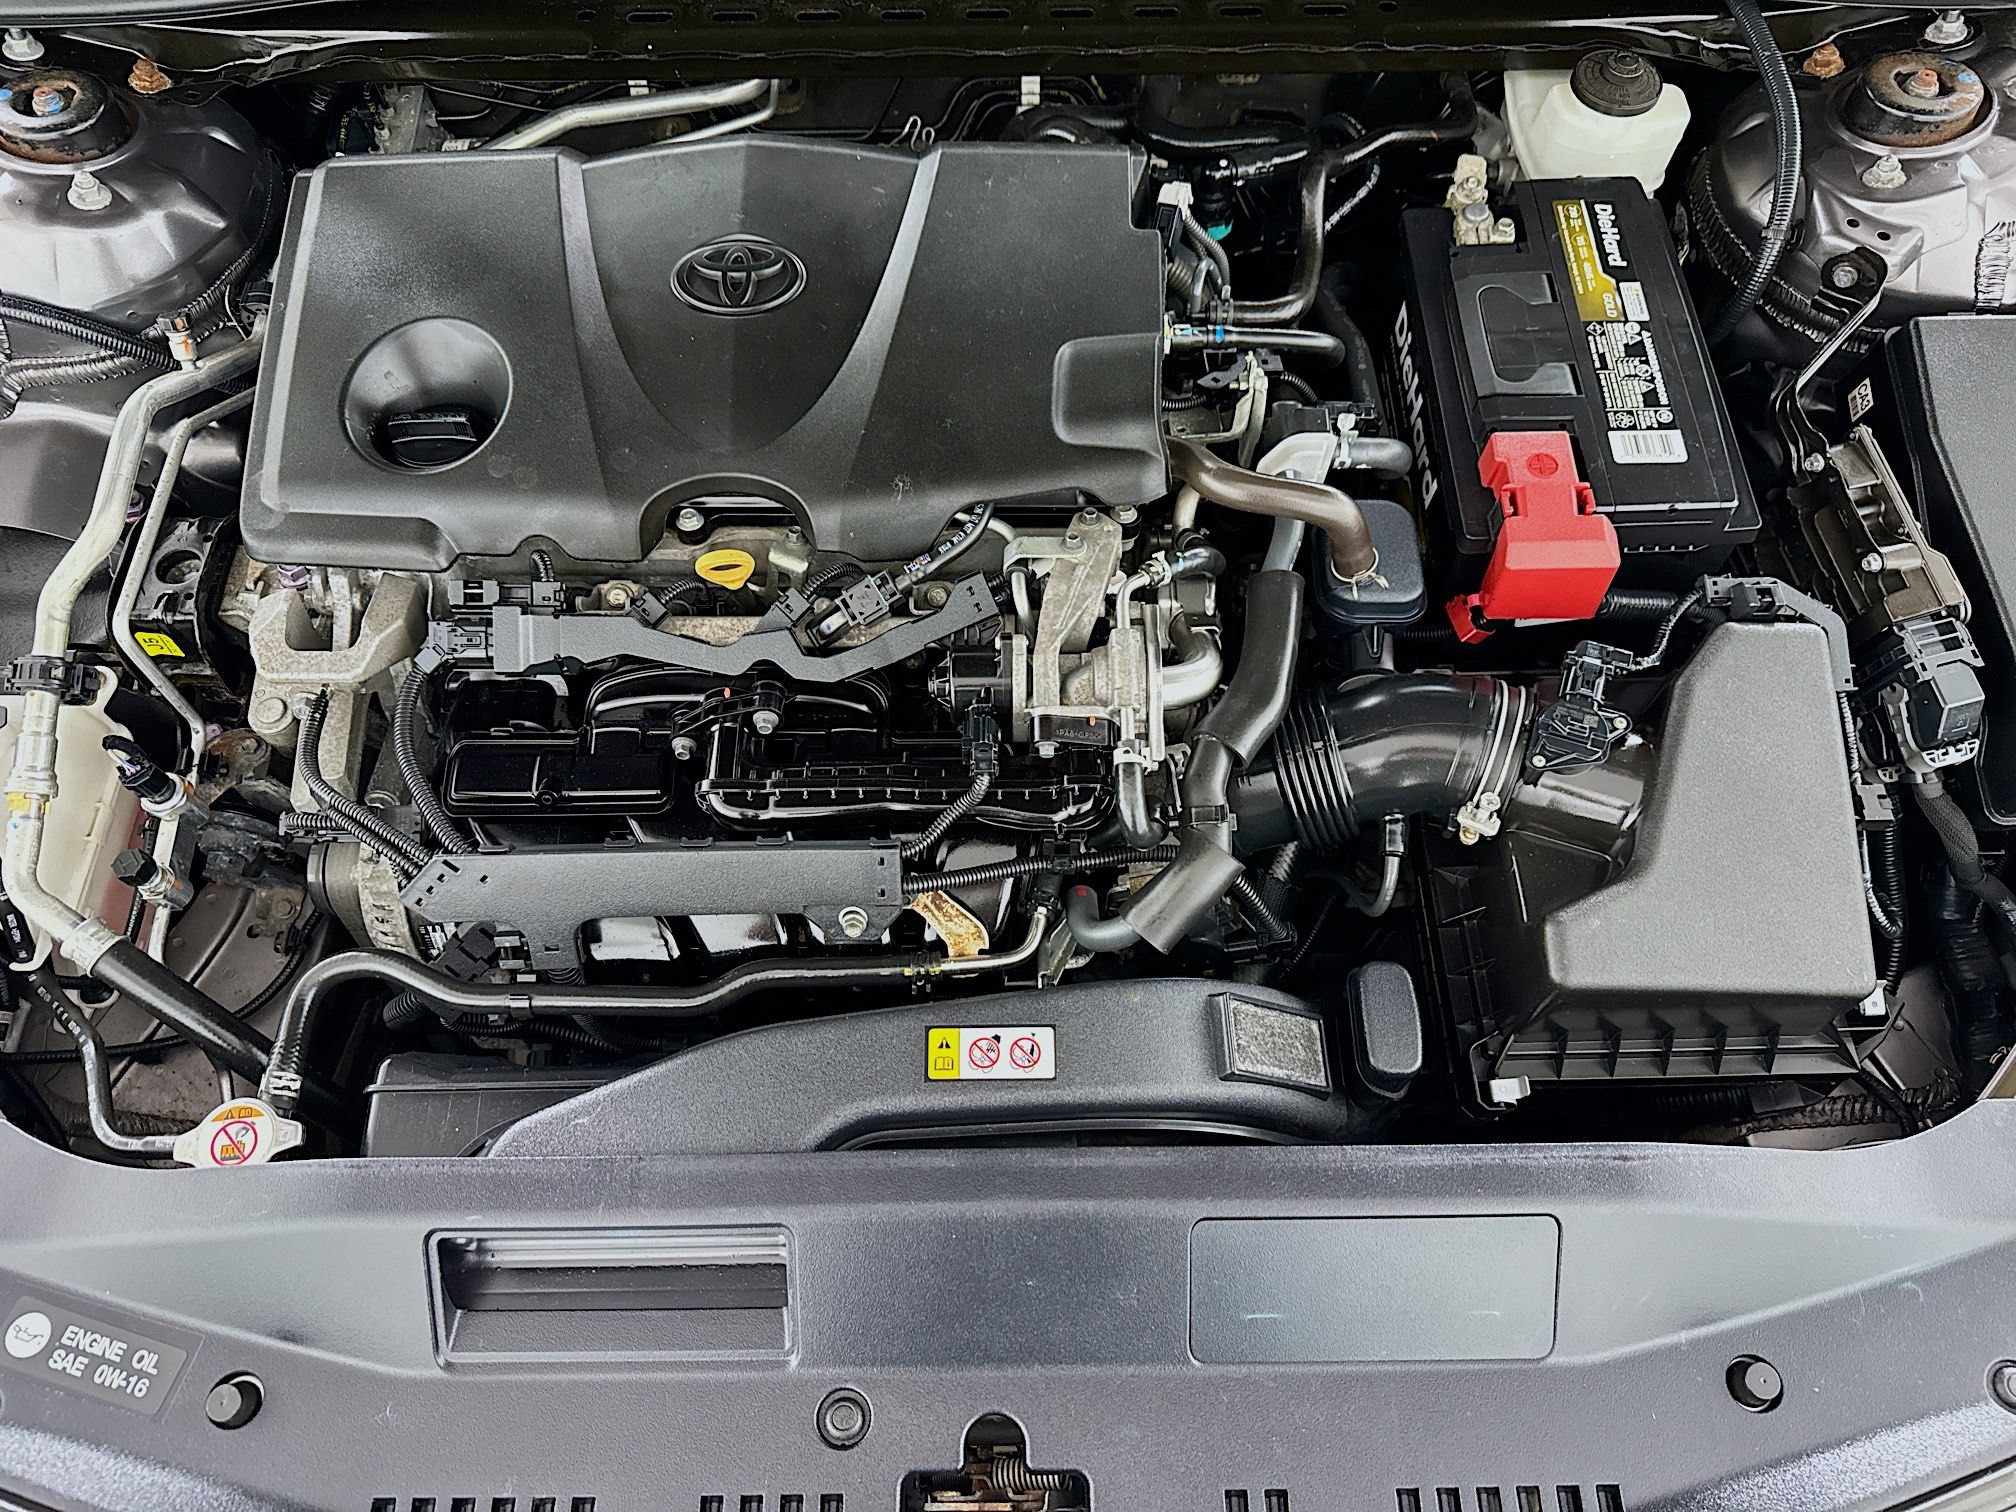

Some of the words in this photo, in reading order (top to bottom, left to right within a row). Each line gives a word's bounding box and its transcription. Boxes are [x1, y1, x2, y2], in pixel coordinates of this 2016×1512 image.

[1594, 203, 1628, 267] DieHard
[1602, 292, 1618, 318] GOLD
[1395, 300, 1438, 511] DieHard
[1858, 383, 1870, 411] CA3
[142, 637, 164, 650] J5
[48, 1349, 89, 1378] SAE
[93, 1364, 150, 1398] 0W-16
[60, 1324, 128, 1363] ENGINE
[131, 1349, 159, 1375] OIL
